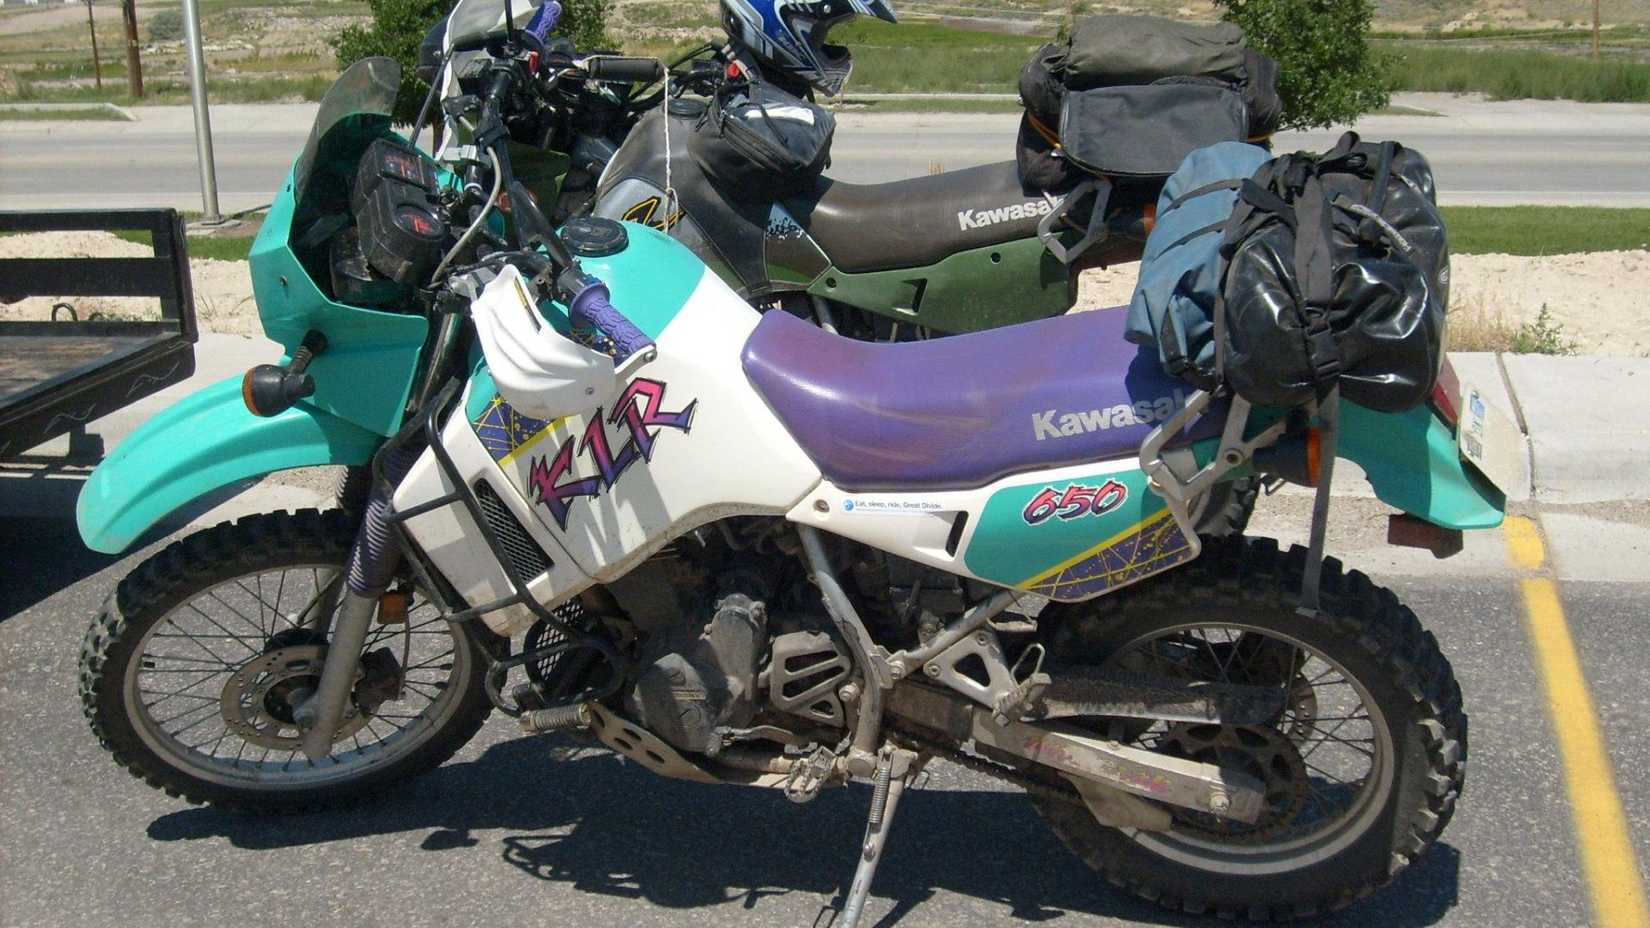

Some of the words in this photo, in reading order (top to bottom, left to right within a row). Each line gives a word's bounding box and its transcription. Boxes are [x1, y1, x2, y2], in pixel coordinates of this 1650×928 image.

[958, 191, 1058, 231] Kawasa
[1031, 387, 1187, 442] Kawasa
[527, 377, 698, 533] KLR
[1023, 477, 1128, 526] 650
